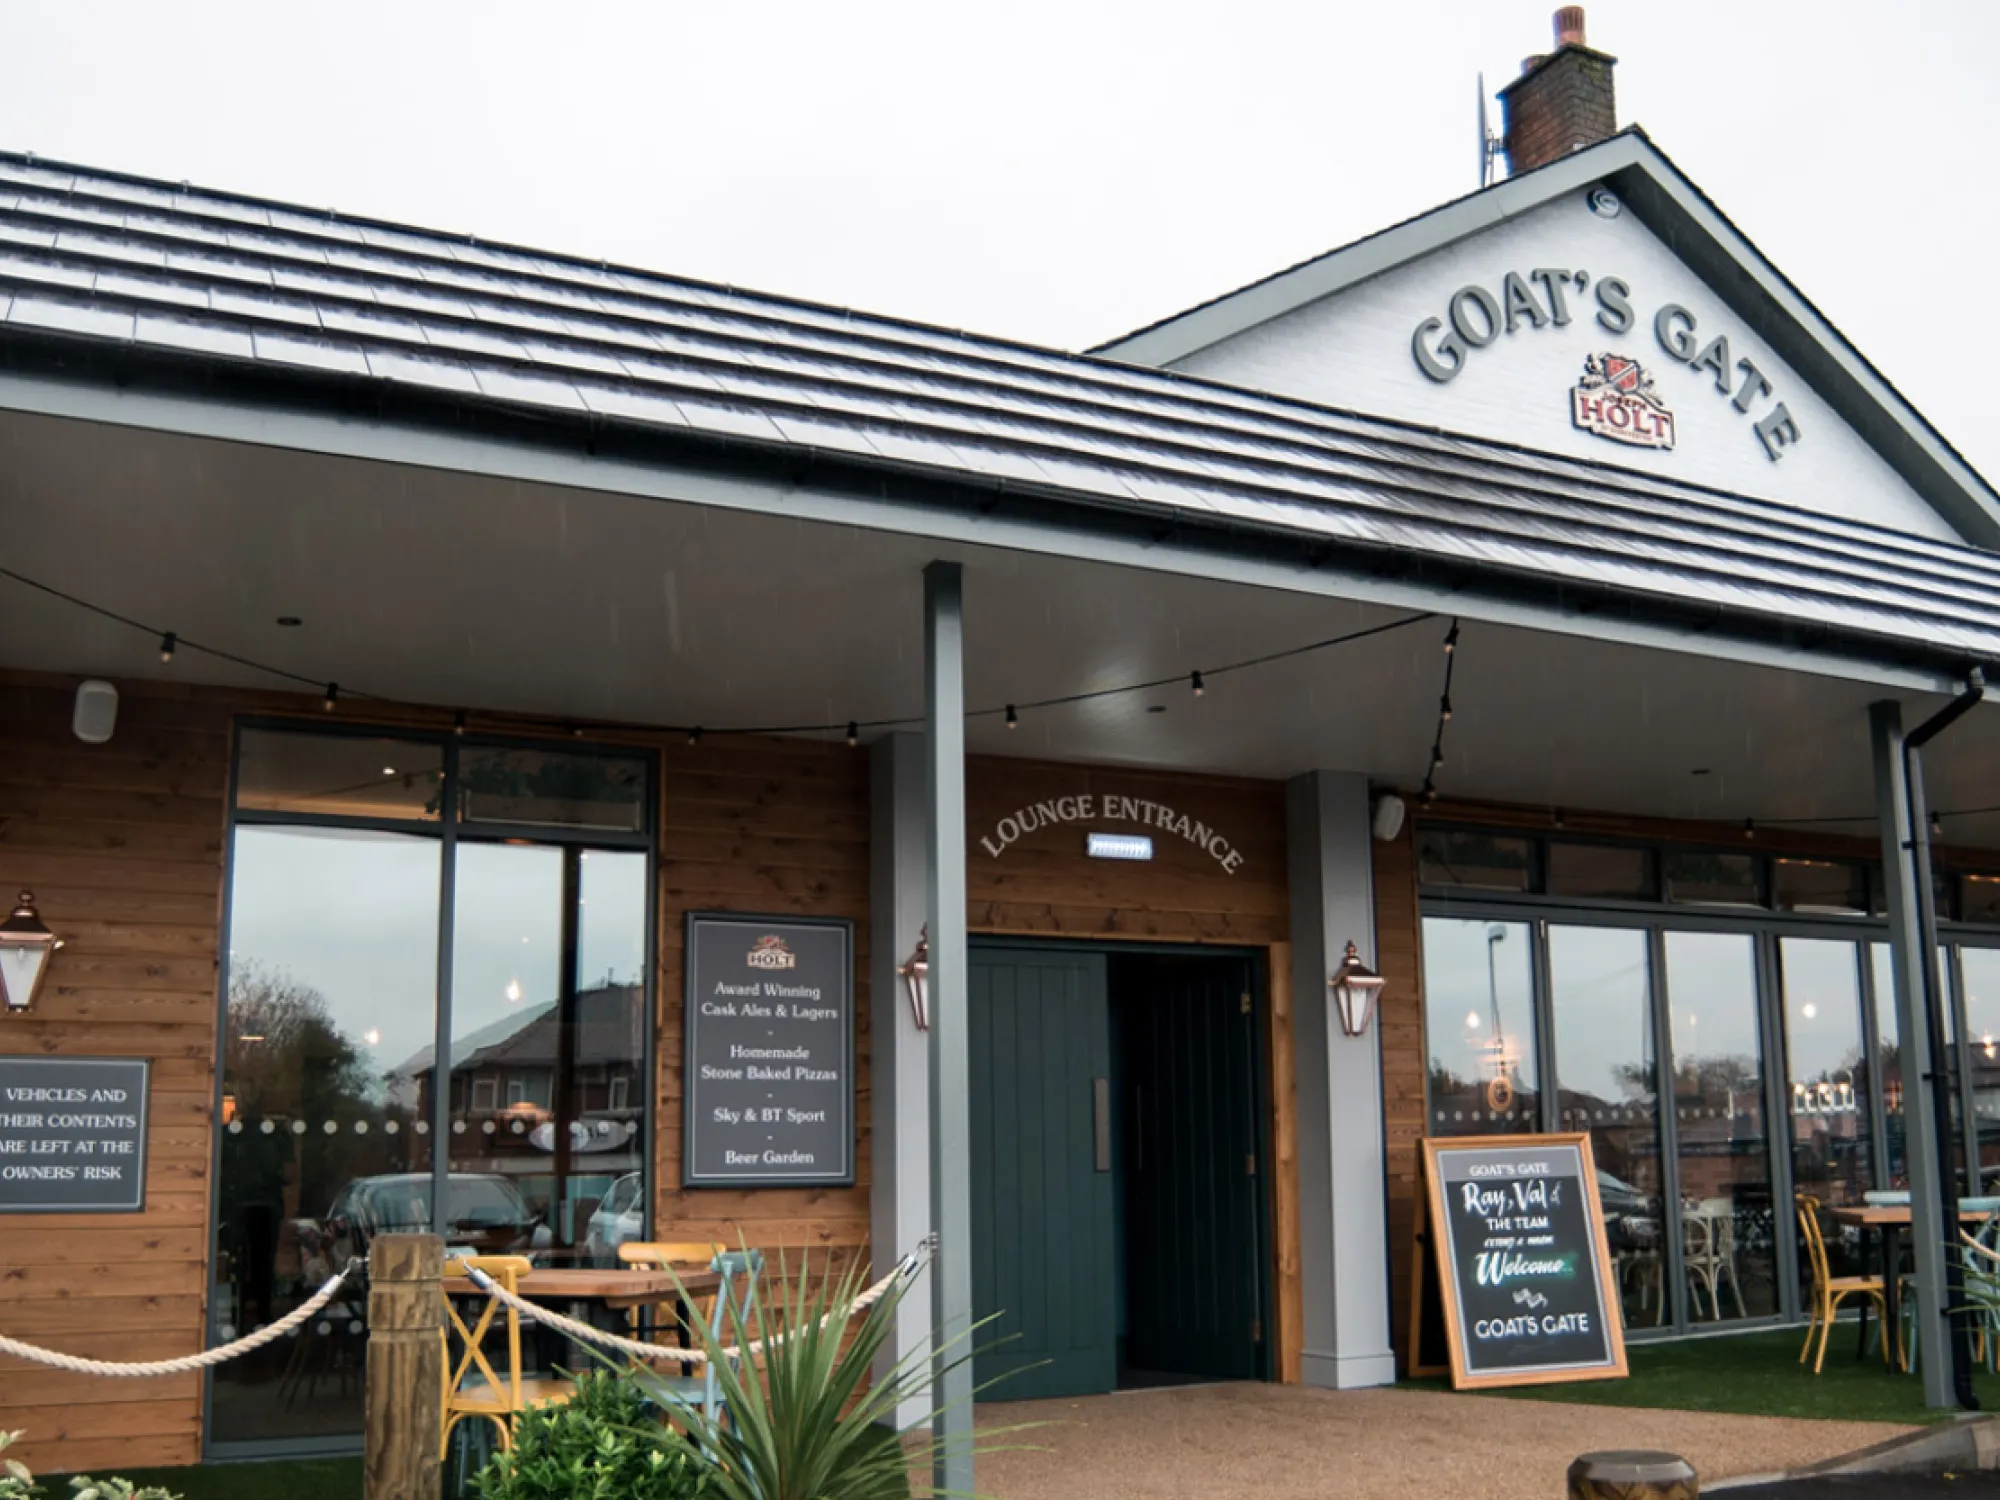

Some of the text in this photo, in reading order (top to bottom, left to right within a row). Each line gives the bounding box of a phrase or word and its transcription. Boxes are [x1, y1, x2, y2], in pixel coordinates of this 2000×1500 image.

[1412, 268, 1802, 462] GOAT'S GATE
[1580, 396, 1671, 438] HOLT
[980, 794, 1244, 875] LOUNGE ENTRANCE
[750, 954, 792, 966] HOLT
[714, 981, 821, 1001] Award Winning
[701, 1002, 838, 1021] Cask Ales & Lagers
[730, 1044, 810, 1060] Homemade
[701, 1065, 838, 1081] Stone Baked Pizzas
[6, 1087, 128, 1102] VEHICLES AND
[48, 1113, 137, 1129] CONTENTS
[714, 1107, 825, 1124] Sky & BT Sport
[31, 1139, 72, 1154] LEFT
[74, 1140, 97, 1154] AT
[100, 1140, 134, 1154] THE
[725, 1150, 814, 1165] Beer Garden
[2, 1165, 122, 1179] OWNERS' RISK
[1469, 1162, 1549, 1177] GOAT'S GATE
[1512, 1179, 1548, 1211] Val
[1485, 1216, 1549, 1231] THE TEAM
[1475, 1312, 1590, 1338] GOAT'S GATE
